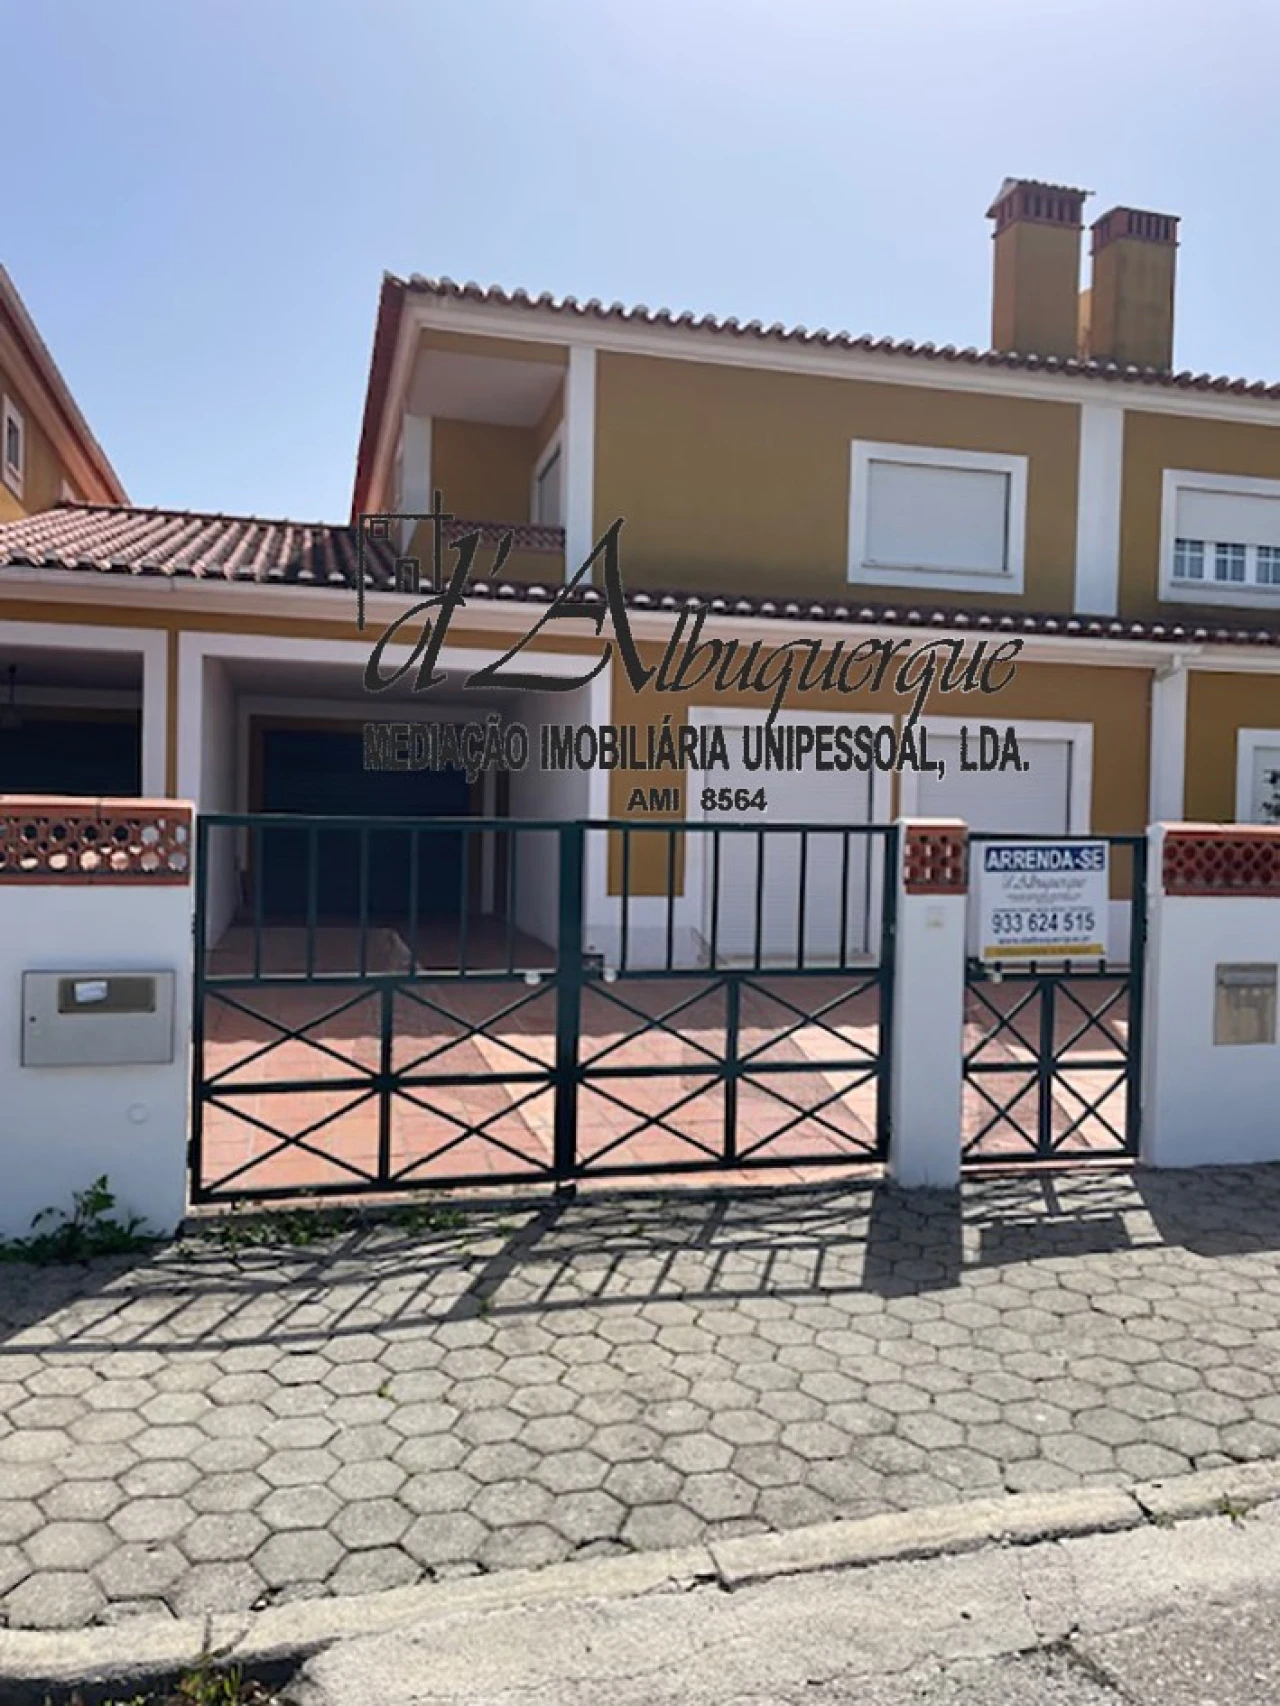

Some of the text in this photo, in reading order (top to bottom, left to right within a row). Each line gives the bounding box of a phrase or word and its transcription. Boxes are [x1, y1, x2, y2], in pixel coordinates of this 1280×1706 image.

[987, 848, 1103, 870] ARRENDA-SE
[992, 911, 1095, 934] 933 624 515
